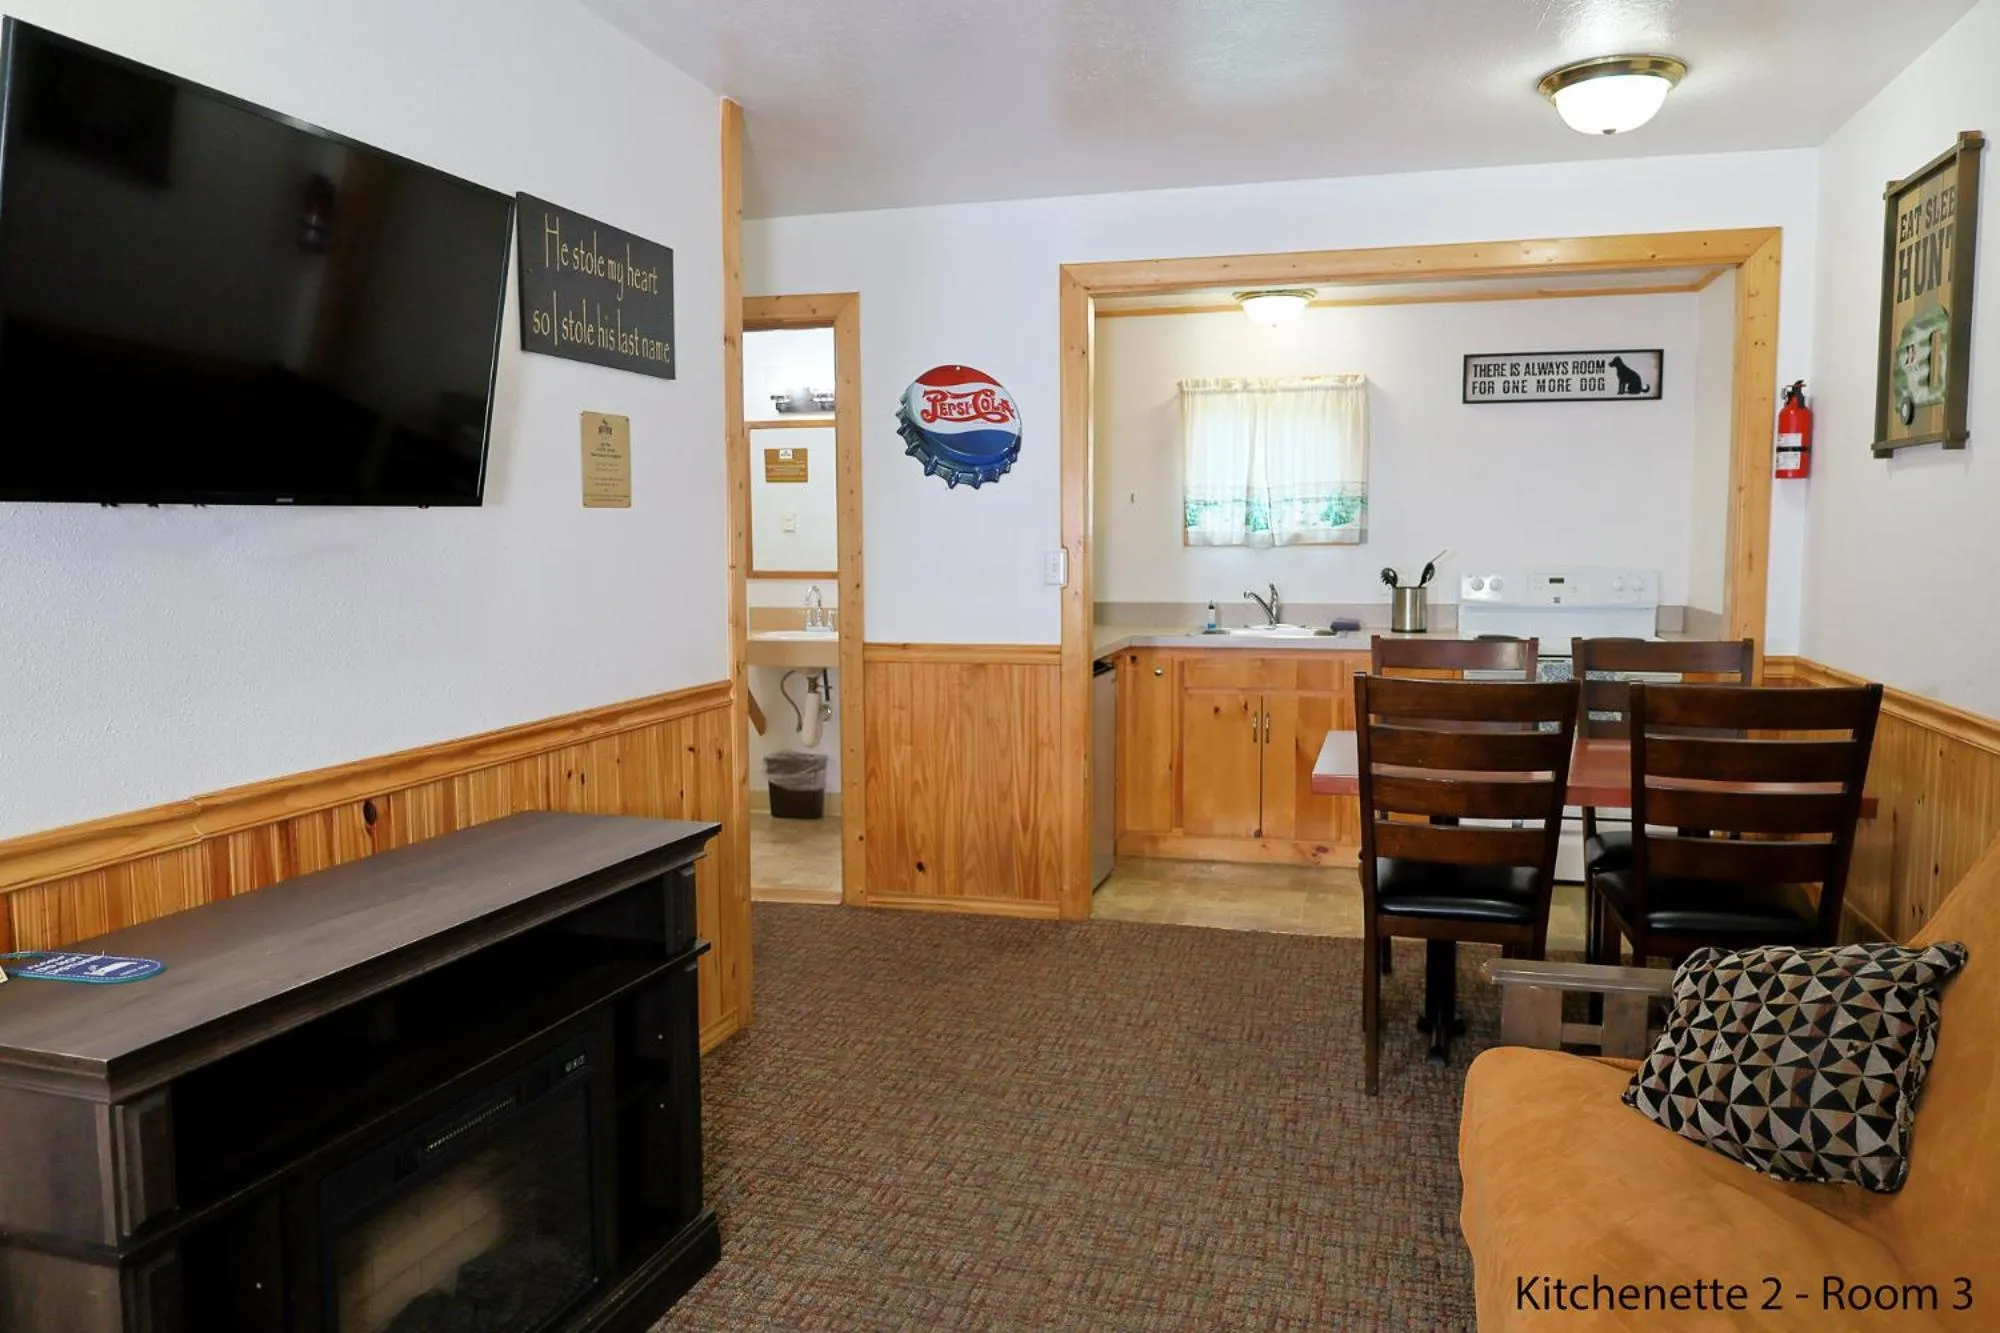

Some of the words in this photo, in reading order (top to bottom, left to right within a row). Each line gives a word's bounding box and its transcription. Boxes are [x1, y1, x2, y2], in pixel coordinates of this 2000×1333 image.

[1900, 204, 1922, 243] EAT
[1925, 185, 1956, 229] SLEE
[544, 212, 569, 272] He
[573, 230, 604, 277] stole
[607, 258, 624, 301] my
[626, 243, 658, 295] heart
[532, 309, 550, 336] so
[553, 290, 559, 346] I
[561, 298, 595, 346] stole
[597, 303, 615, 351] his
[617, 308, 640, 357] last
[641, 337, 671, 363] name
[1471, 380, 1495, 396] FOR
[1502, 379, 1528, 394] ONE
[1536, 378, 1571, 393] MORE
[1580, 377, 1606, 392] DOG
[1472, 363, 1507, 379] THERE
[1510, 362, 1521, 377] IS
[1524, 360, 1569, 377] ALWAYS
[1572, 360, 1606, 375] ROOM
